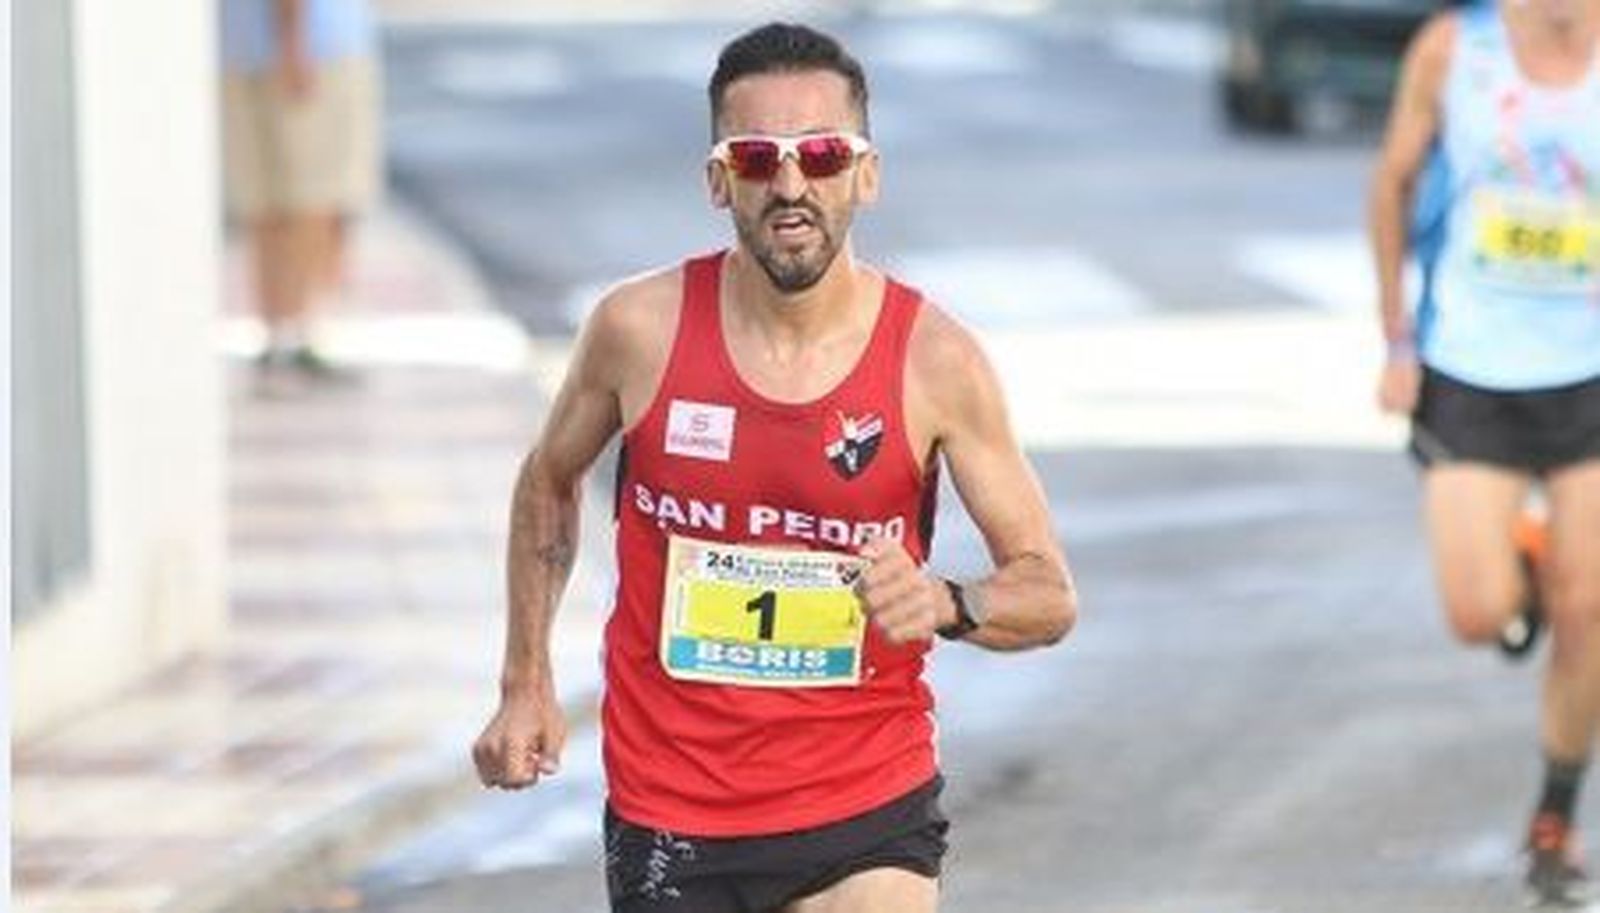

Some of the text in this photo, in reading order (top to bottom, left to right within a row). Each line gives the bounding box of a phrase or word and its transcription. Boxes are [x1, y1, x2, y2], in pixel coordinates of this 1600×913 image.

[634, 484, 905, 546] SAN PEDRO
[746, 590, 776, 641] 1
[697, 640, 828, 669] BORIS
